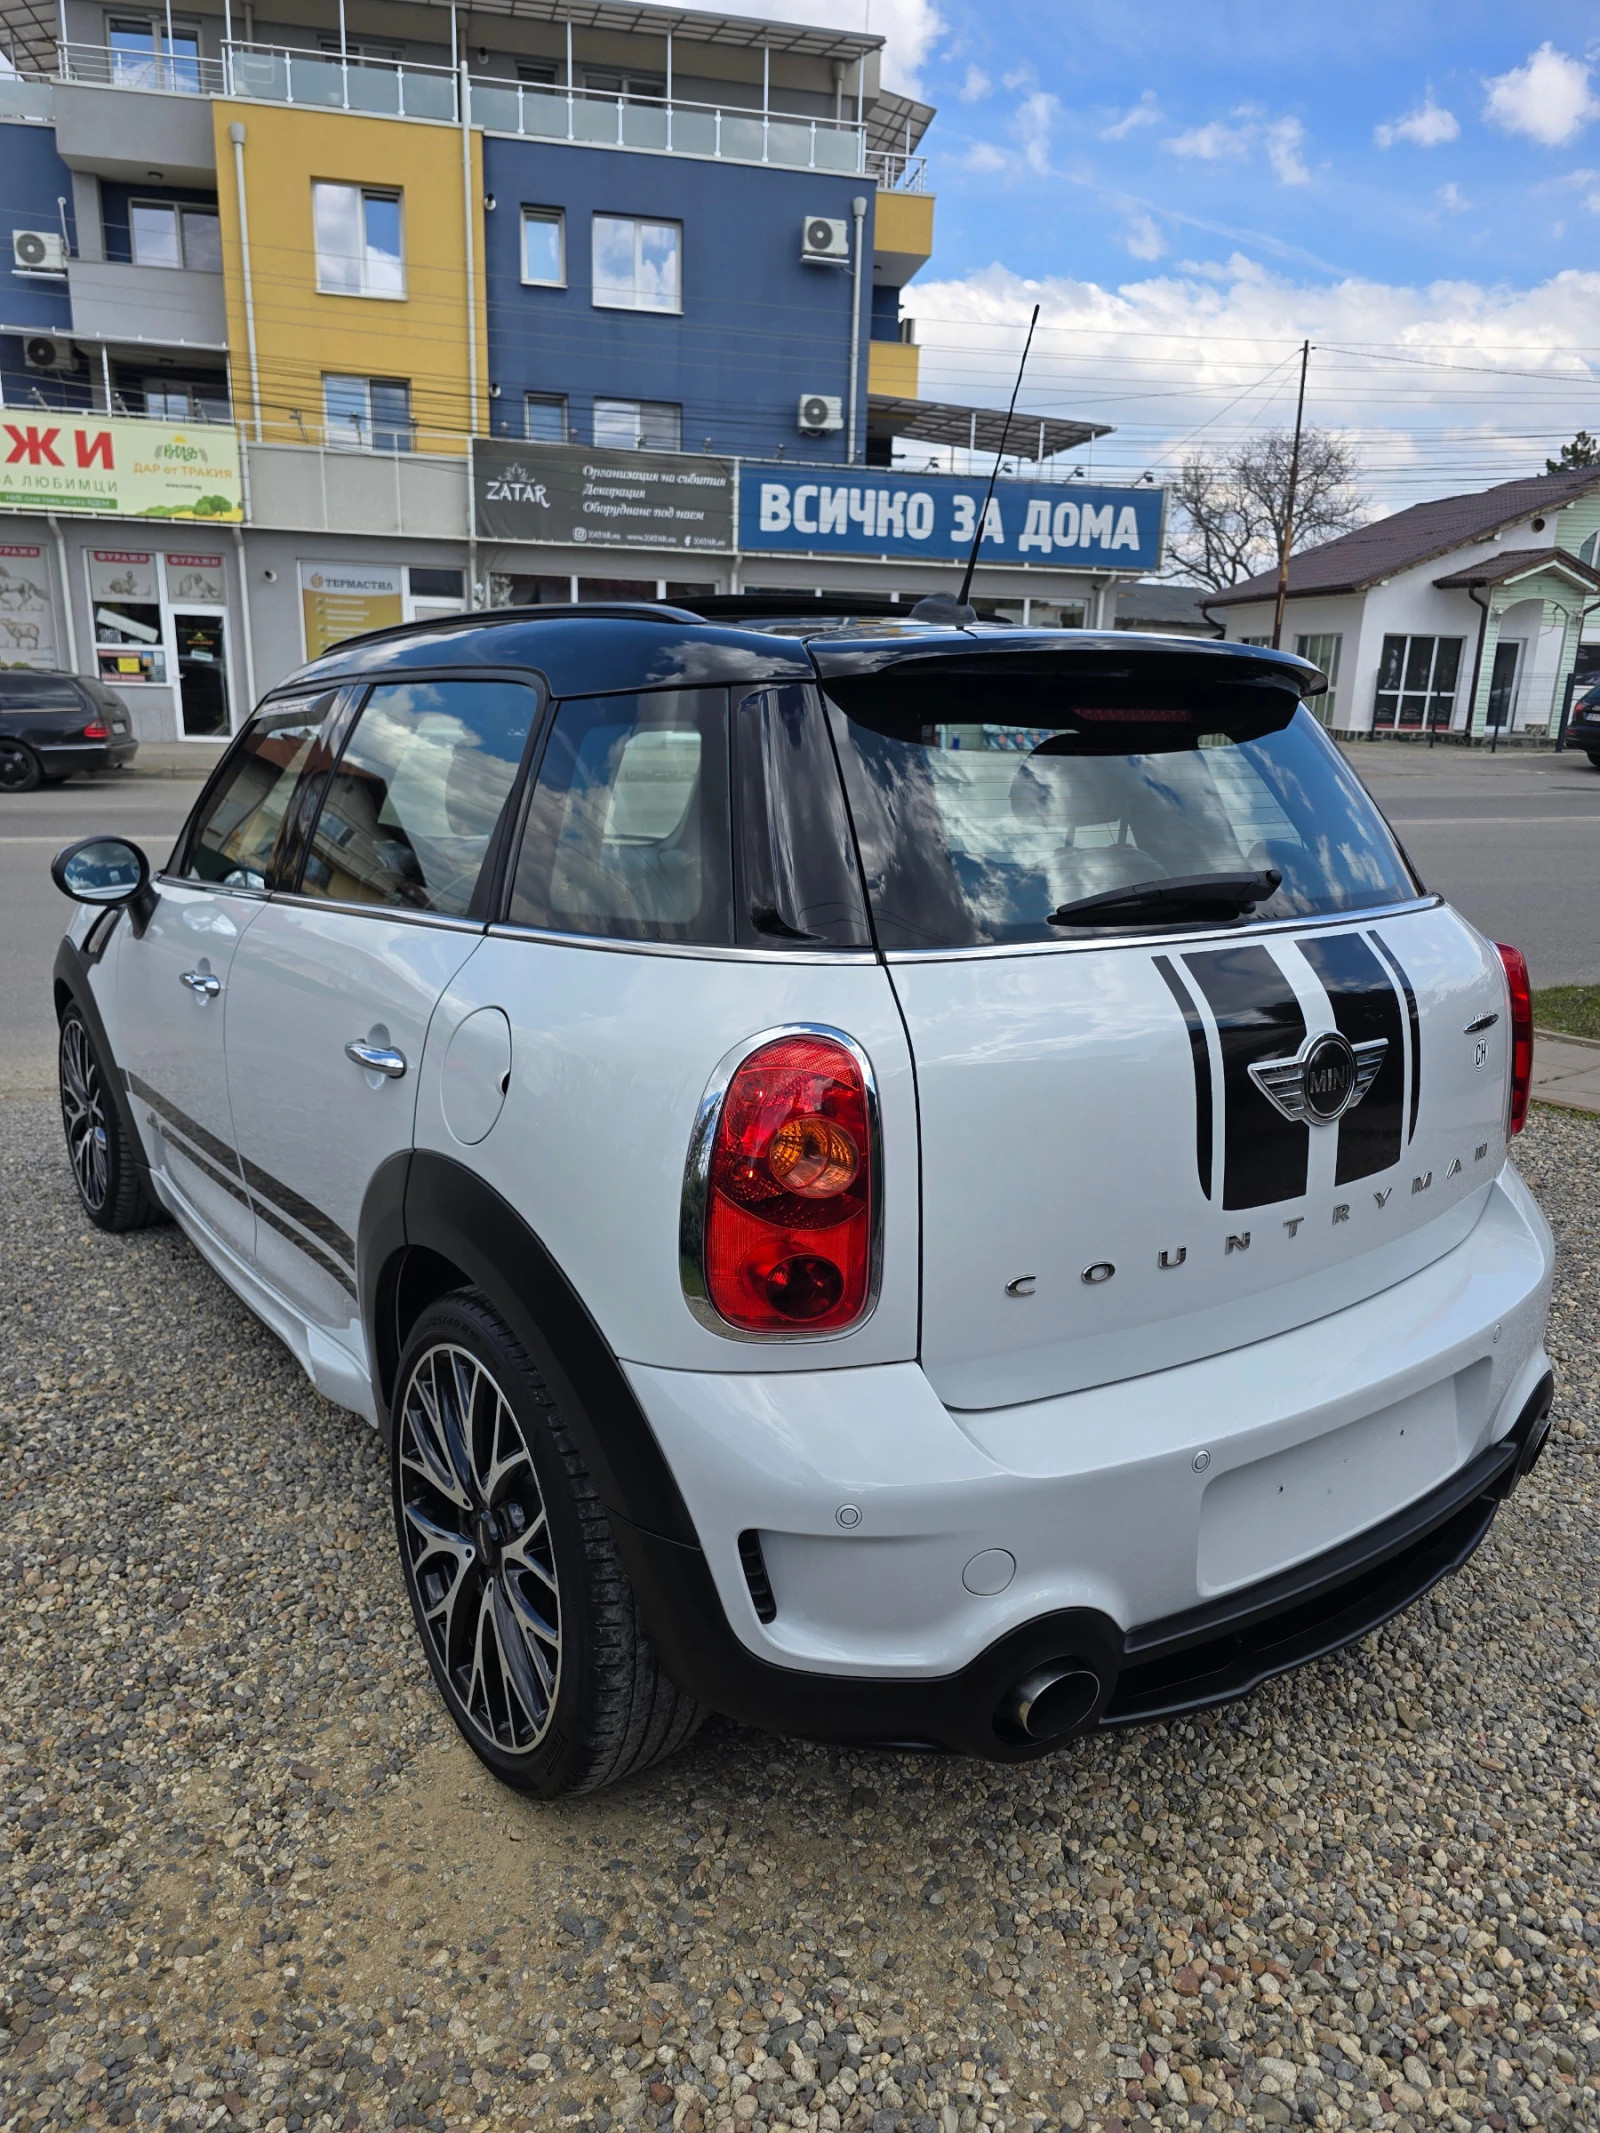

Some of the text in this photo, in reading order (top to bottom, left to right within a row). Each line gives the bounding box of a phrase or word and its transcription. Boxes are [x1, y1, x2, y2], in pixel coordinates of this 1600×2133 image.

[133, 462, 233, 480] ДАР от ТРАКИЯ
[582, 465, 727, 487] Организация на събития
[22, 475, 118, 493] ЛЮБИМЦИ
[582, 483, 646, 500] Декорация
[485, 481, 550, 508] ZATAR
[582, 501, 705, 521] Оборудване под наем
[759, 483, 1141, 553] ВСИЧКО ЗА ДОМА
[97, 551, 148, 562] ФУРАЖИ
[171, 556, 219, 566] ФУРАЖИ
[325, 578, 393, 591] ТЕРМАСТИЛ
[1475, 1041, 1487, 1066] CH
[1309, 1064, 1350, 1094] MINI
[1005, 1141, 1488, 1298] COUNTRYMAN
